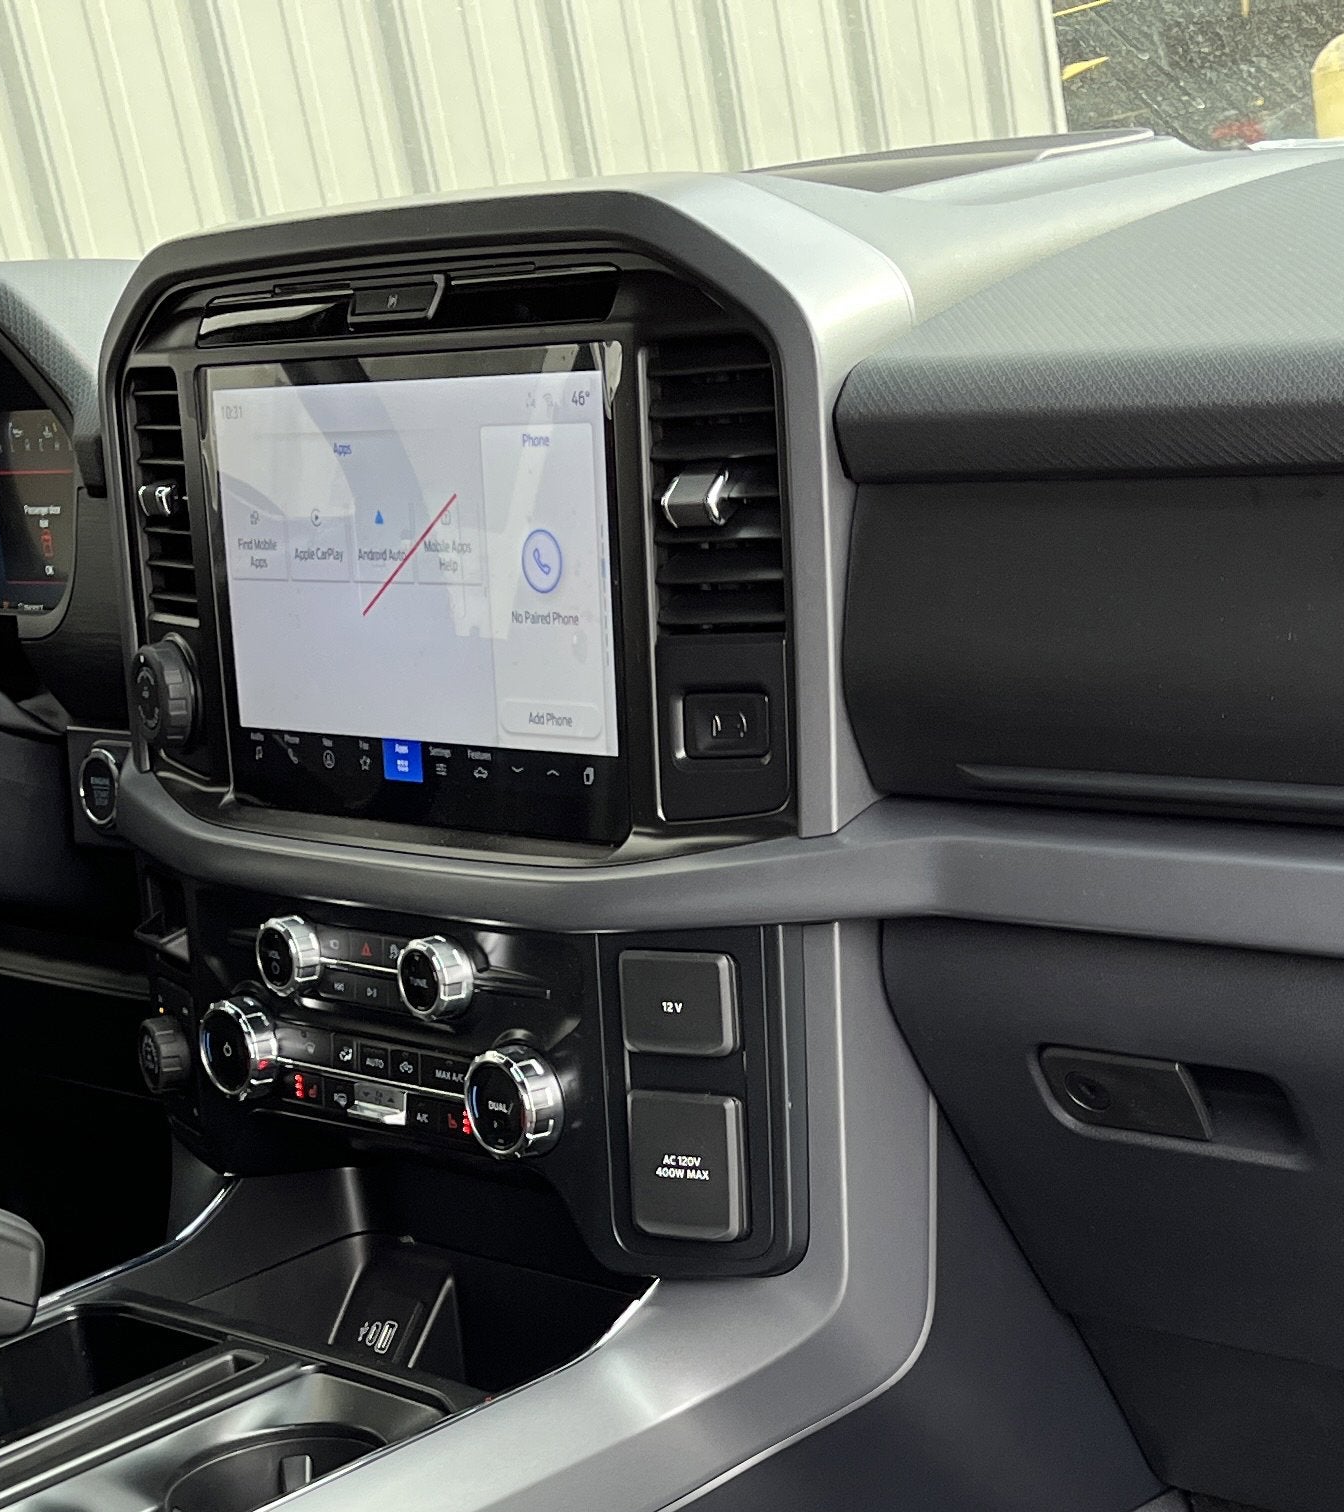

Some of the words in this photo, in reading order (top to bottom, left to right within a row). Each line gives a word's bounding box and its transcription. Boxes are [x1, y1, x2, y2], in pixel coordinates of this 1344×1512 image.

[522, 433, 550, 447] Phone
[333, 442, 353, 456] Apps
[237, 538, 253, 550] Find
[254, 538, 277, 551] Mobile
[423, 540, 450, 553] Mobile
[452, 541, 472, 555] Apps
[294, 548, 315, 562] Apple
[316, 547, 344, 562] CarPlay
[357, 548, 387, 562] Android
[388, 548, 406, 561] Auto
[250, 555, 268, 570] Apps
[439, 557, 458, 573] Help
[511, 610, 524, 624] No
[524, 610, 551, 625] Paired
[552, 611, 579, 626] Phone
[528, 711, 544, 725] Add
[546, 712, 573, 727] Phone
[661, 1001, 674, 1013] 12
[674, 1001, 683, 1013] V
[365, 1057, 385, 1069] AUTO
[435, 1069, 451, 1081] MAX
[488, 1100, 508, 1113] DUAL
[662, 1154, 676, 1166] AC
[677, 1155, 702, 1167] 120V
[655, 1166, 685, 1179] 400W
[686, 1168, 709, 1181] MAX
